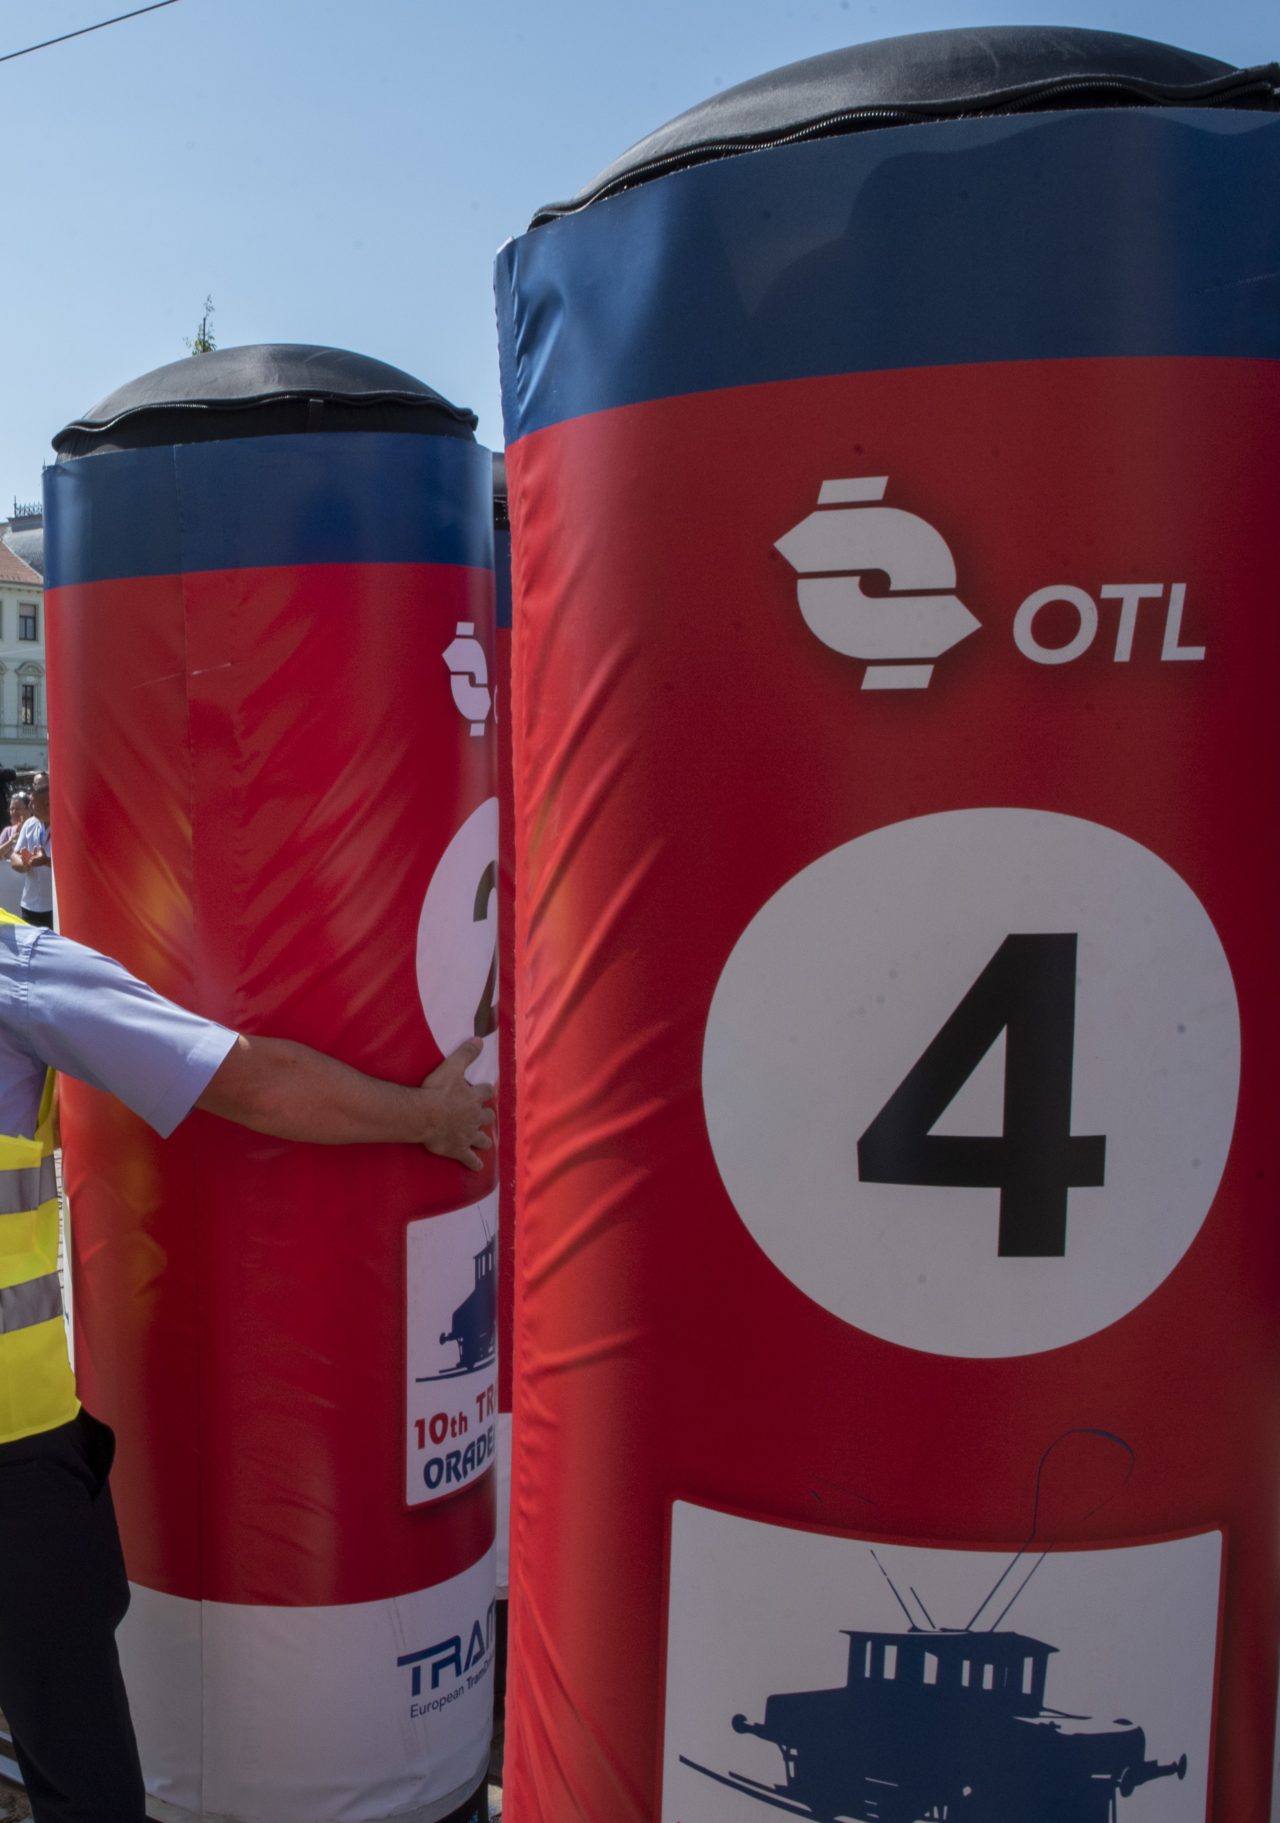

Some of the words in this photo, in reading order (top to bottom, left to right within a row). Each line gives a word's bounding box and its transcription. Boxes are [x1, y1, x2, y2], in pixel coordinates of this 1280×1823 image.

[1013, 582, 1207, 666] OTL
[857, 932, 1107, 1258] 4
[414, 1411, 468, 1450] 10th
[476, 1383, 497, 1424] TR
[423, 1423, 496, 1490] ORADE
[410, 1686, 465, 1718] European
